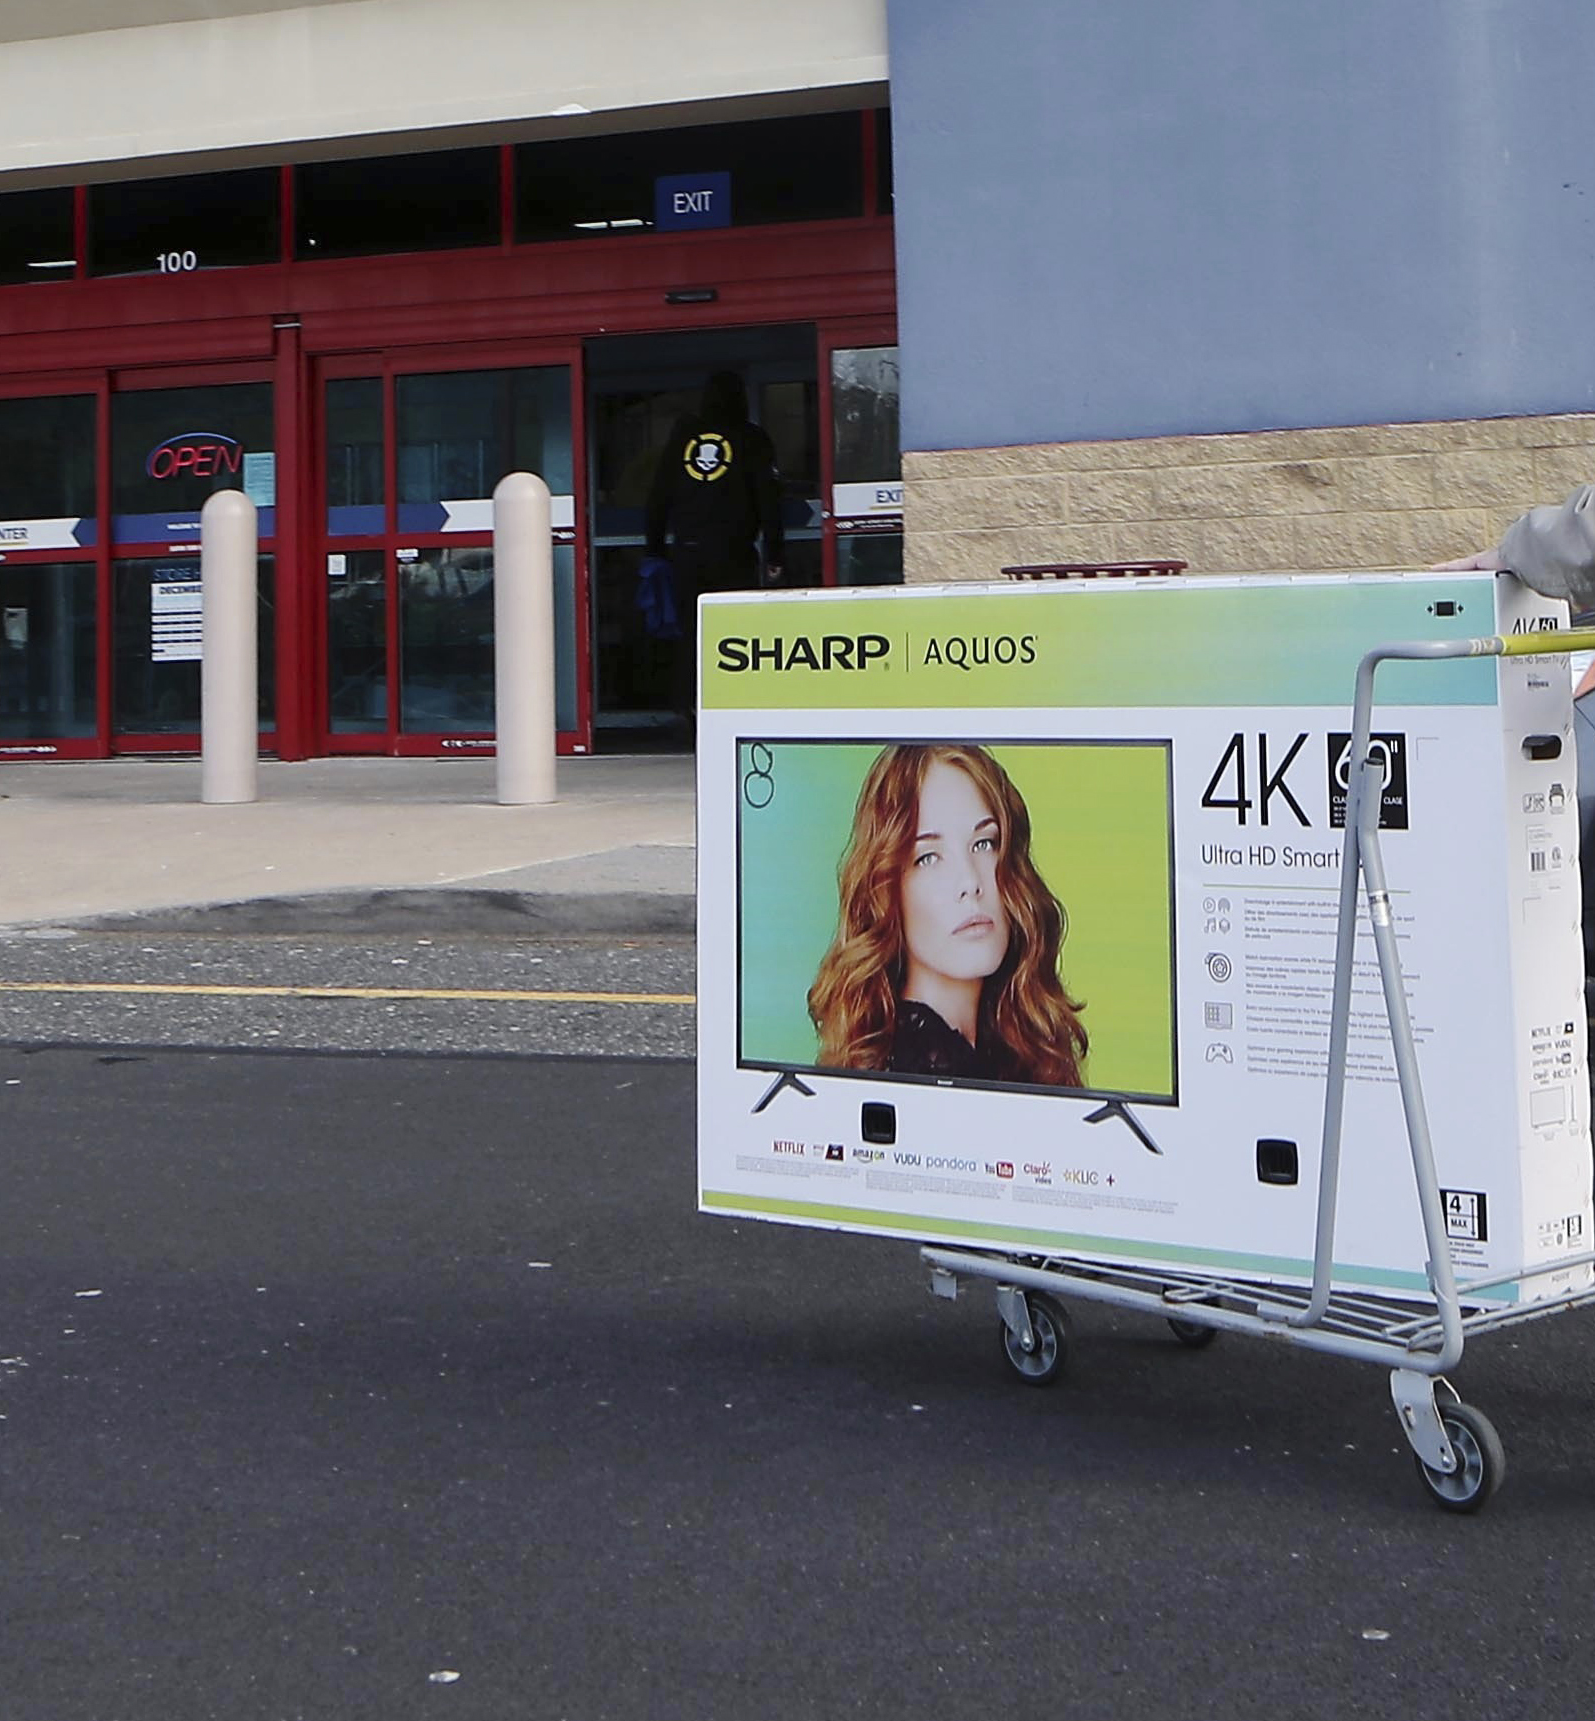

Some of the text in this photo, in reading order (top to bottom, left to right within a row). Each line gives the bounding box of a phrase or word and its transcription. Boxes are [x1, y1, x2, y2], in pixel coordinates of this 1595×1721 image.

[672, 189, 713, 216] EXIT
[156, 250, 197, 273] 100
[150, 444, 243, 479] OPEN
[716, 634, 1037, 673] SHARP AQUOS
[1201, 732, 1313, 828] 4K
[1201, 843, 1243, 866] Ultra
[1248, 845, 1277, 867] HD
[1282, 845, 1341, 870] Smart
[773, 1140, 806, 1157] NETFLIX
[852, 1147, 885, 1162] amazon
[893, 1152, 922, 1167] VUDU
[926, 1156, 977, 1173] pandora
[1023, 1160, 1050, 1177] Claro
[1449, 1194, 1462, 1214] 4
[1450, 1218, 1468, 1229] MAX
